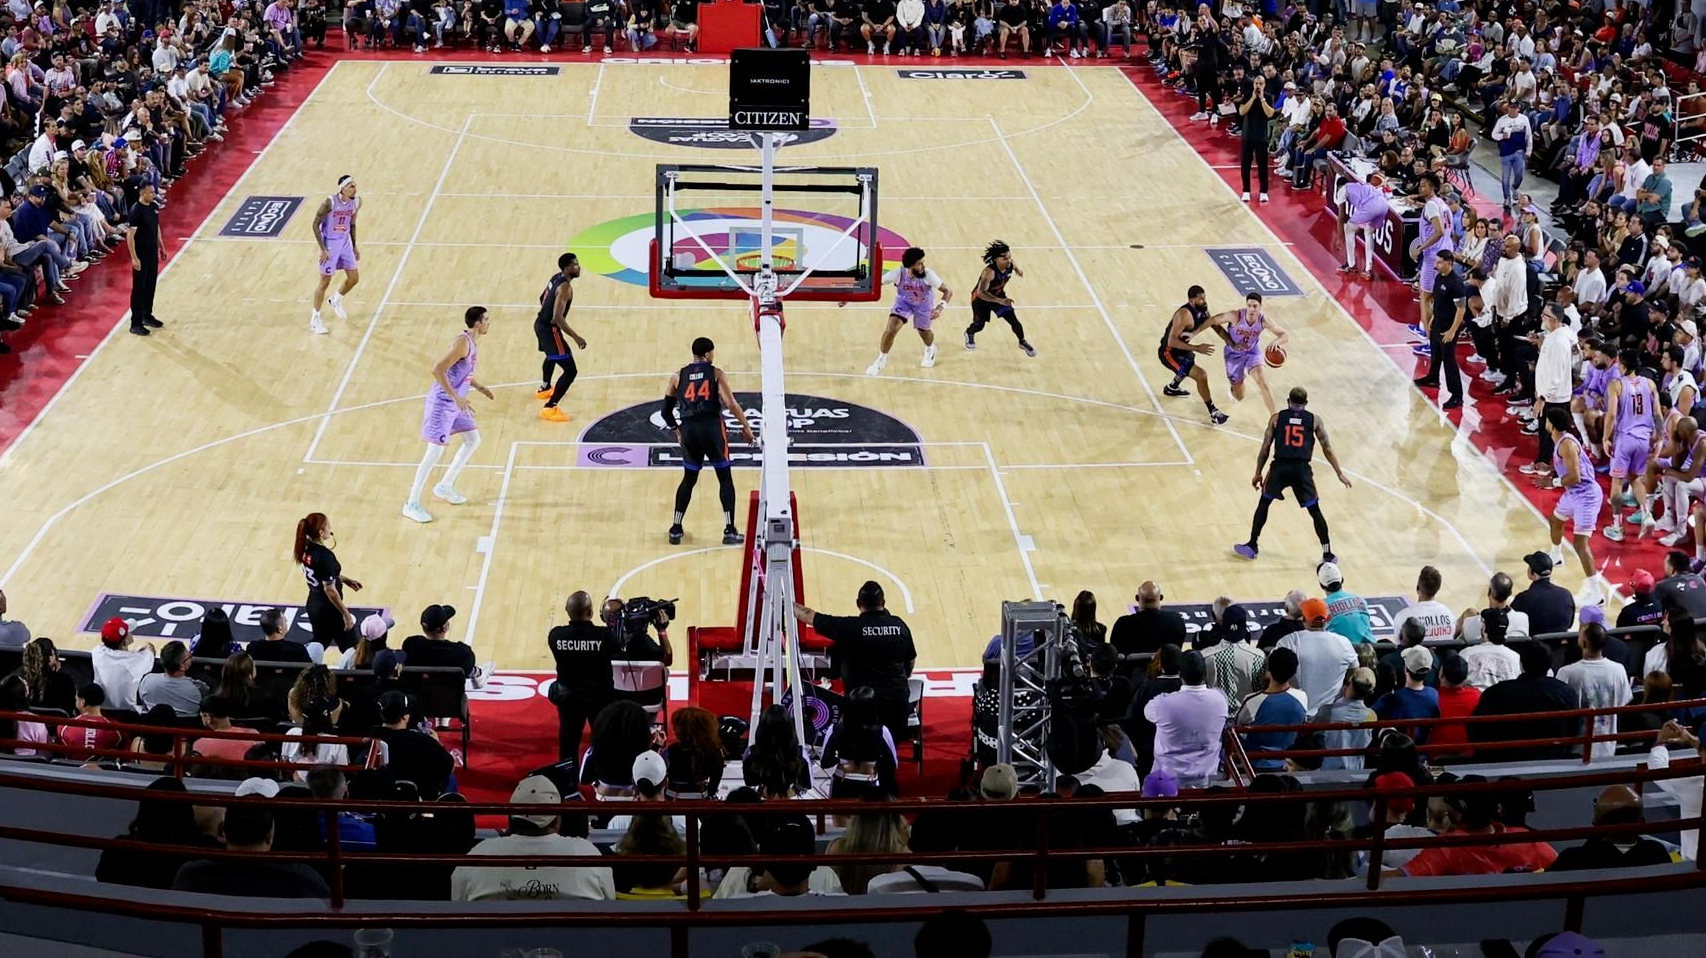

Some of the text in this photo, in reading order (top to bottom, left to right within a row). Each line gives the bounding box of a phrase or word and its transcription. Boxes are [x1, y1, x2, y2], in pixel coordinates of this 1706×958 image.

[733, 111, 804, 126] CITIZEN
[1241, 255, 1279, 290] ECONO
[684, 379, 711, 402] 44
[1631, 393, 1644, 416] 13
[722, 408, 851, 419] CAUAS
[723, 418, 815, 429] COP
[1283, 425, 1306, 447] 15
[862, 625, 902, 637] SECURITY
[556, 639, 603, 651] SECURITY
